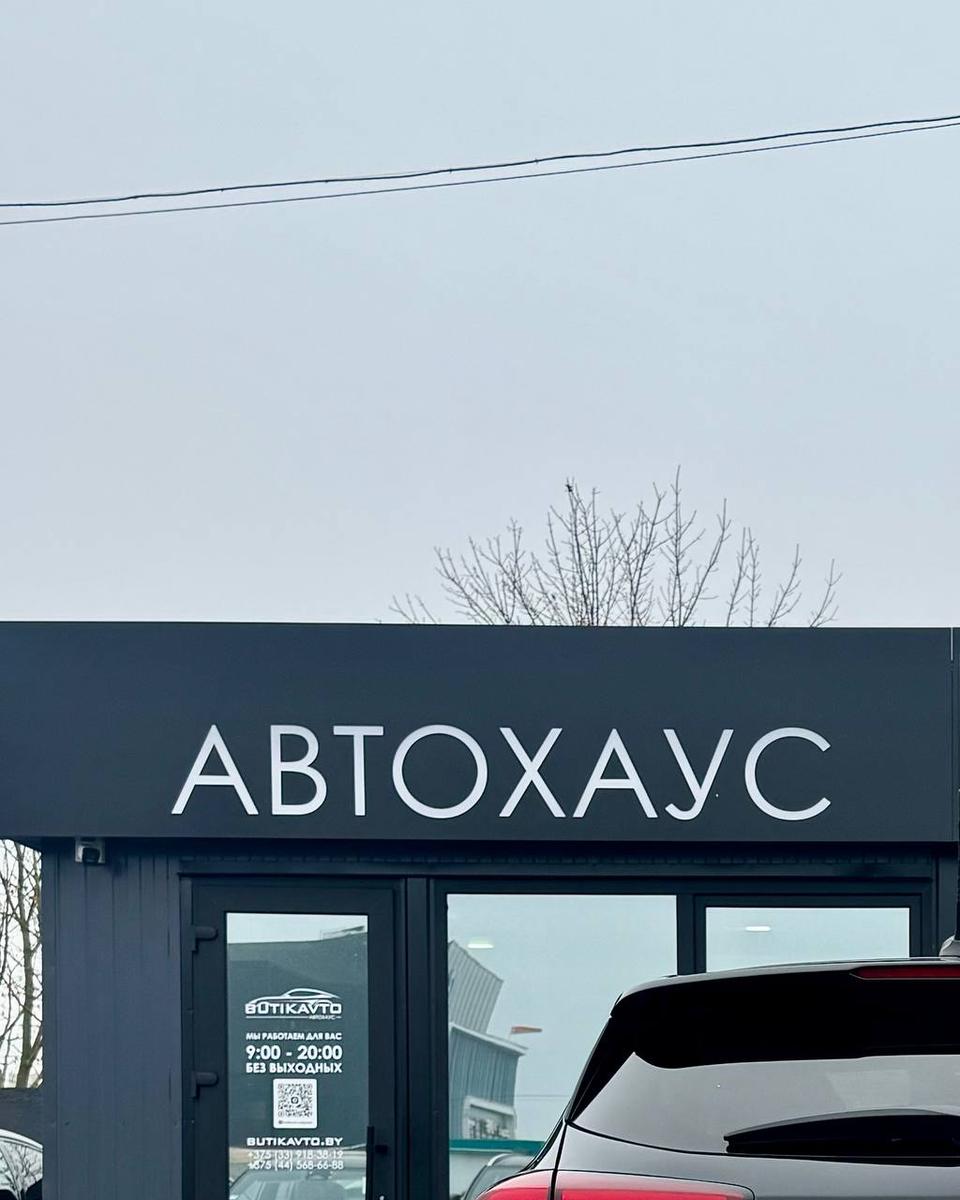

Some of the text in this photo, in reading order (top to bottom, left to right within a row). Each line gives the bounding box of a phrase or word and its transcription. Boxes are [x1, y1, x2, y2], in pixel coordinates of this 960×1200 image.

[171, 723, 832, 822] АВТОХАУС
[245, 1002, 342, 1015] BUTIKAVTO
[245, 1032, 343, 1041] МЫ РАБОТАЕМ ДЛЯ ВАС
[245, 1045, 281, 1060] 9:00
[297, 1045, 343, 1060] 20:00
[245, 1062, 343, 1075] БЕЗ ВЫХОДНЫХ
[246, 1137, 344, 1147] BUTIKAVTO.BY
[248, 1150, 272, 1160] +375
[274, 1150, 293, 1161] (33)
[248, 1160, 344, 1172] +375 (44) 568-66-88
